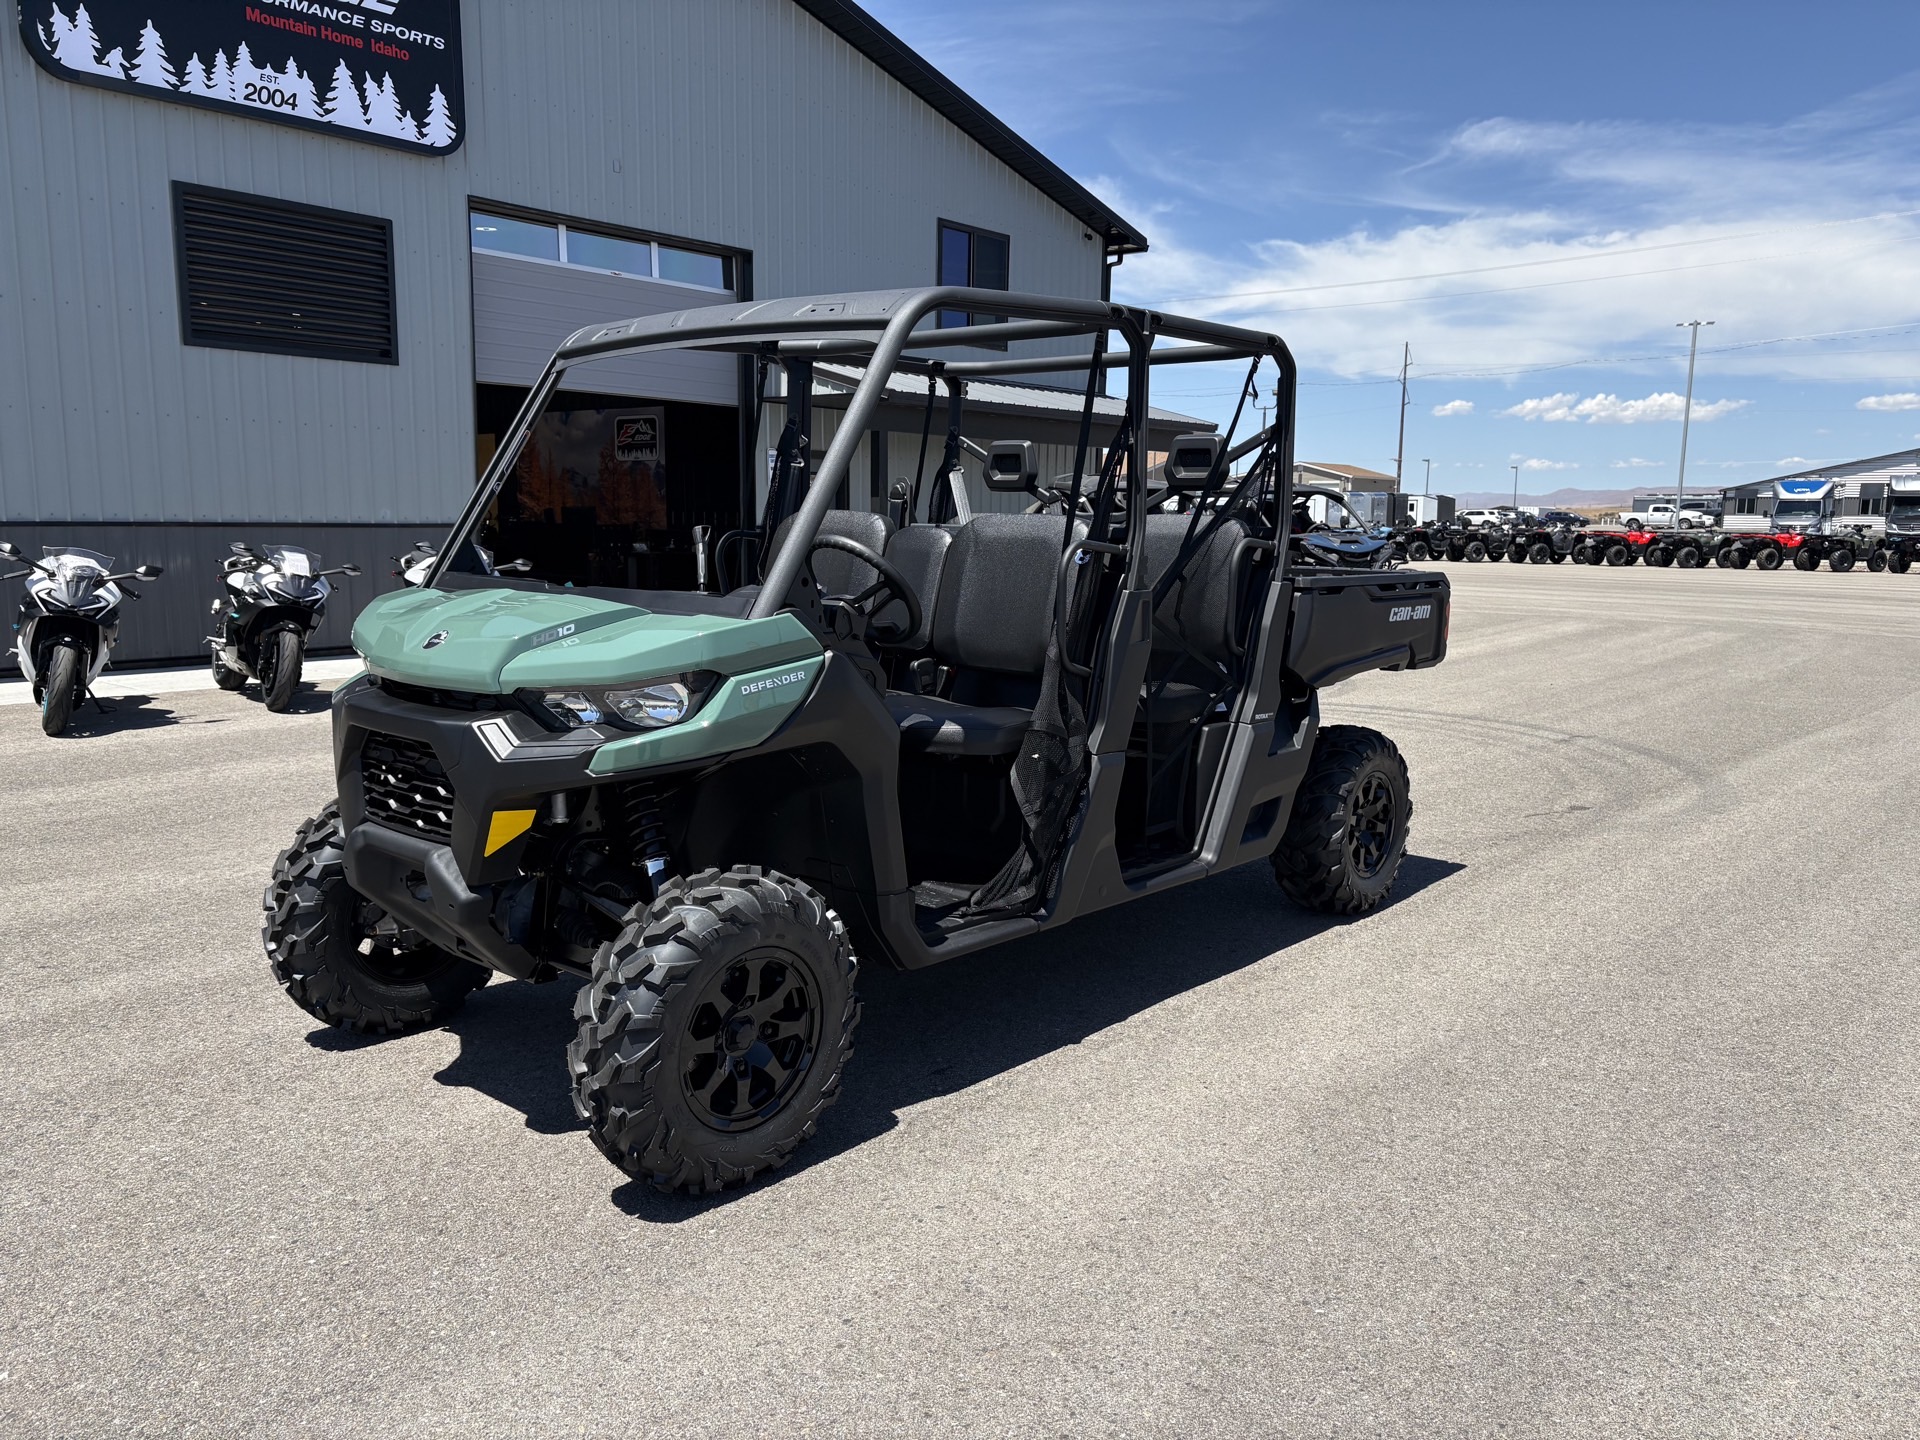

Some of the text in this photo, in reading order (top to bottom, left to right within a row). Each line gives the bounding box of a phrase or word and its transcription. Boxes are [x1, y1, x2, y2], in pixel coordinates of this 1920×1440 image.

[245, 6, 317, 37] Mountain
[320, 25, 364, 49] Home
[370, 38, 410, 61] Idaho
[370, 19, 445, 50] SPORTS
[259, 73, 280, 85] EST.
[243, 82, 298, 111] 2004
[531, 623, 575, 647] HD10
[741, 671, 806, 695] DEFENDER
